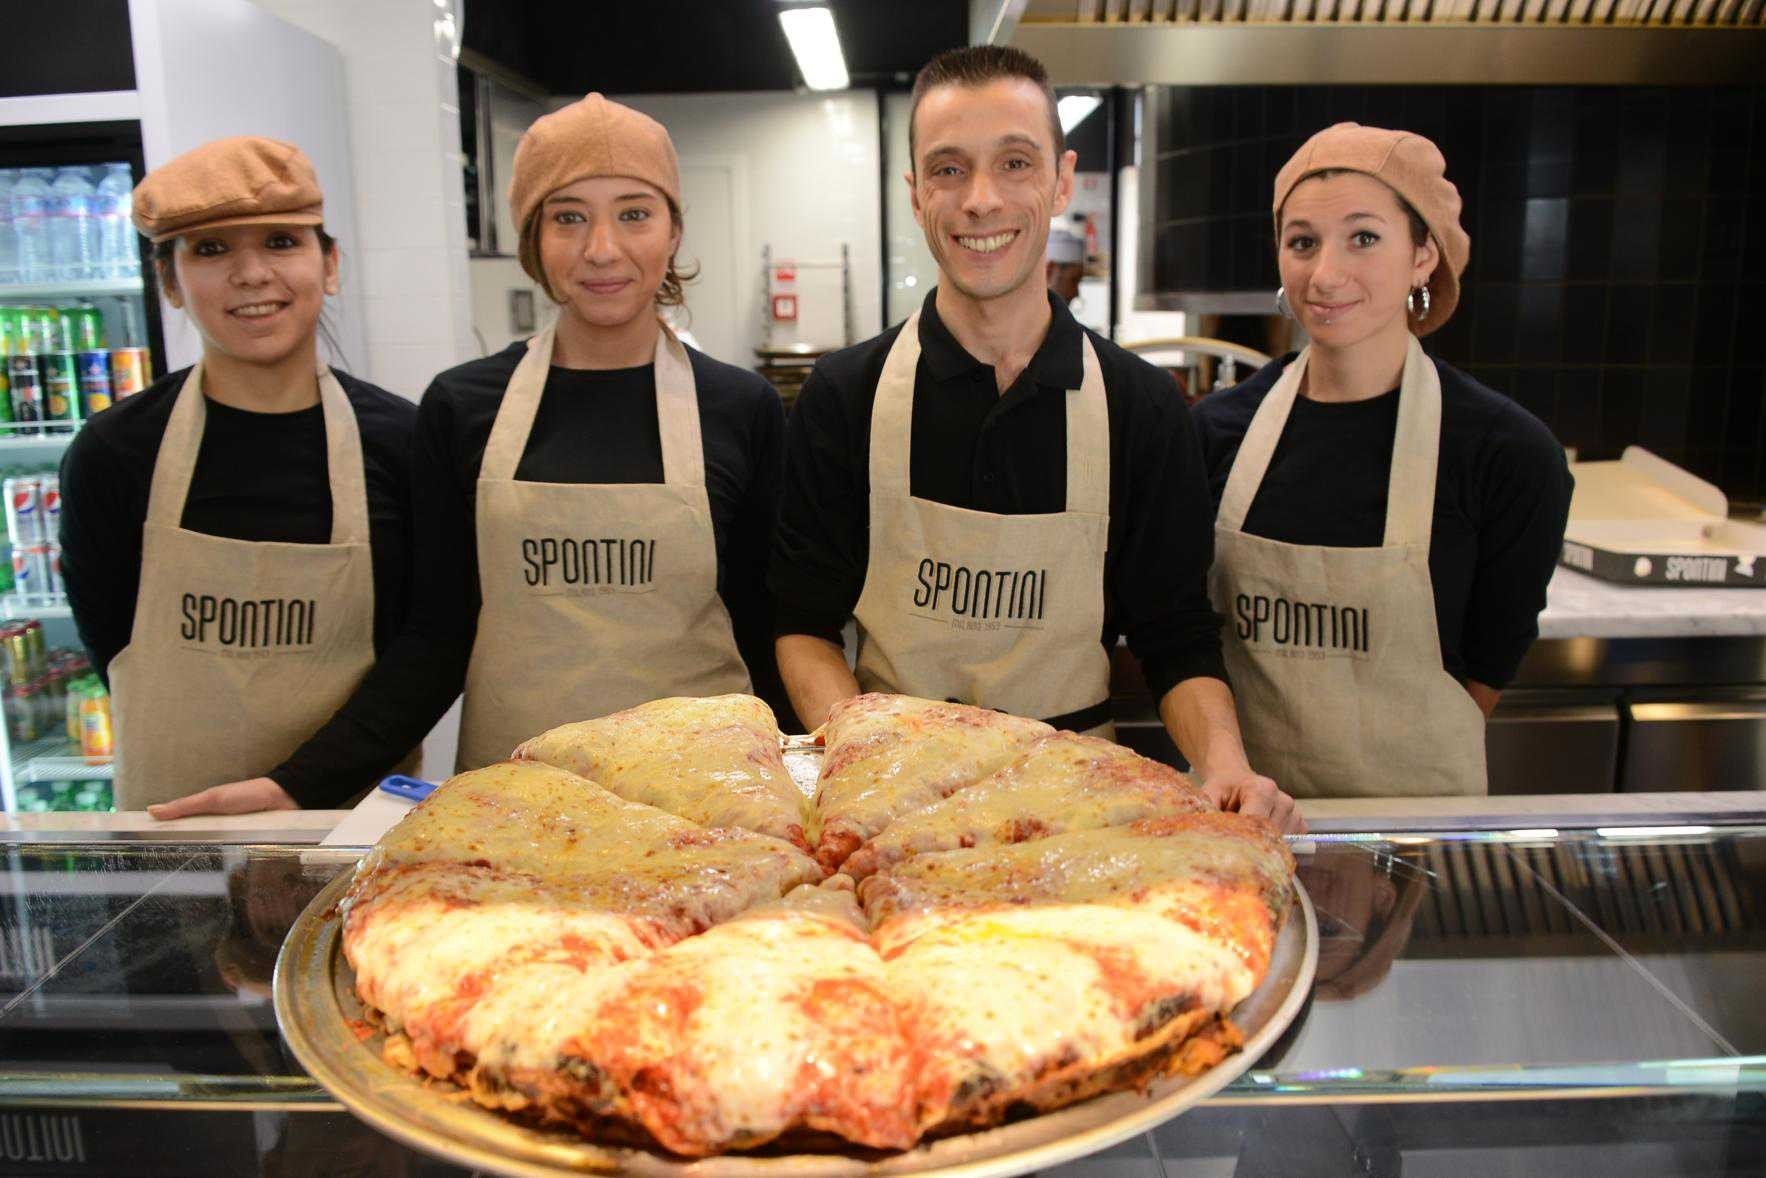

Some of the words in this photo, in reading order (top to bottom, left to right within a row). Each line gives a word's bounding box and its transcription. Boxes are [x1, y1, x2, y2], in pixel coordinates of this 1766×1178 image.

[522, 538, 656, 586] SPONTINI
[913, 558, 1046, 620] SPONTINI
[181, 592, 316, 648] SPONTINI
[1236, 593, 1369, 652] SPONTINI
